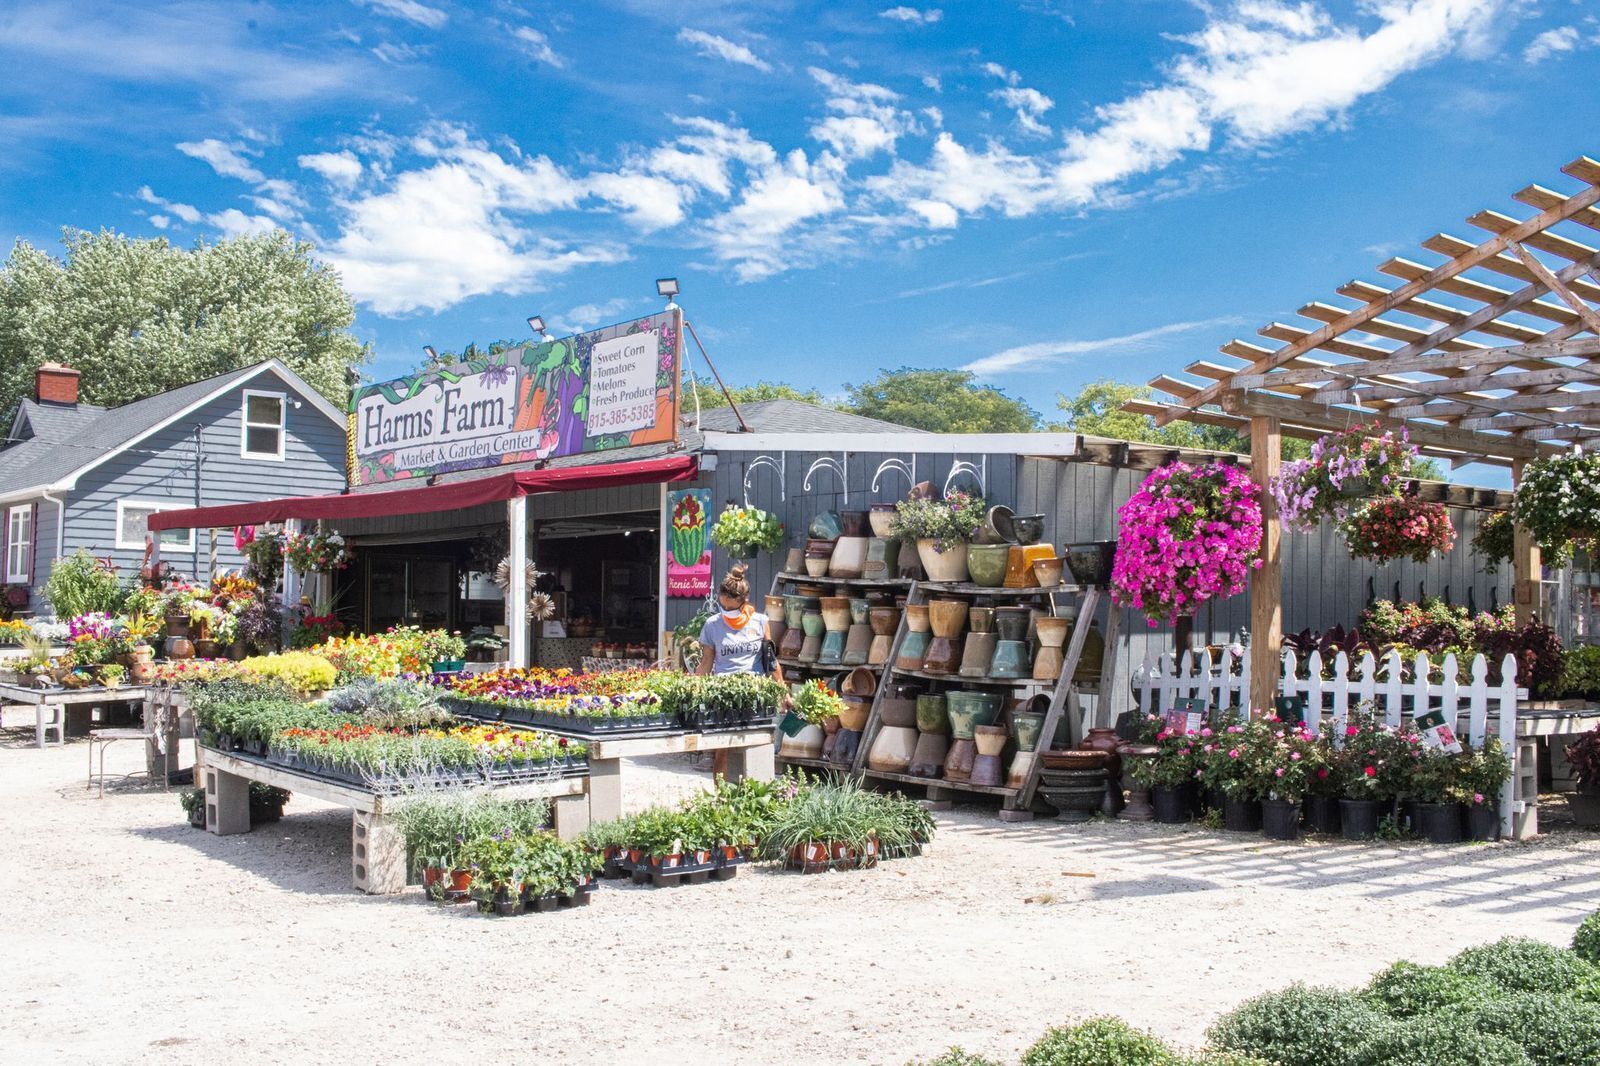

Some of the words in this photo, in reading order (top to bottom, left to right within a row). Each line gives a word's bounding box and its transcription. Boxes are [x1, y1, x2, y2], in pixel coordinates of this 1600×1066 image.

[597, 349, 621, 364] Sweet
[624, 345, 645, 358] Corn
[597, 361, 636, 378] Tomatoes
[597, 378, 626, 392] Melons
[595, 392, 618, 406] Fresh
[620, 386, 655, 402] Produce
[364, 404, 433, 448] Harms
[440, 388, 504, 435] Farm
[589, 403, 654, 429] 815-385-5385
[401, 448, 435, 467] Market
[437, 448, 445, 460] &
[449, 440, 490, 459] Garden
[493, 434, 534, 453] Center
